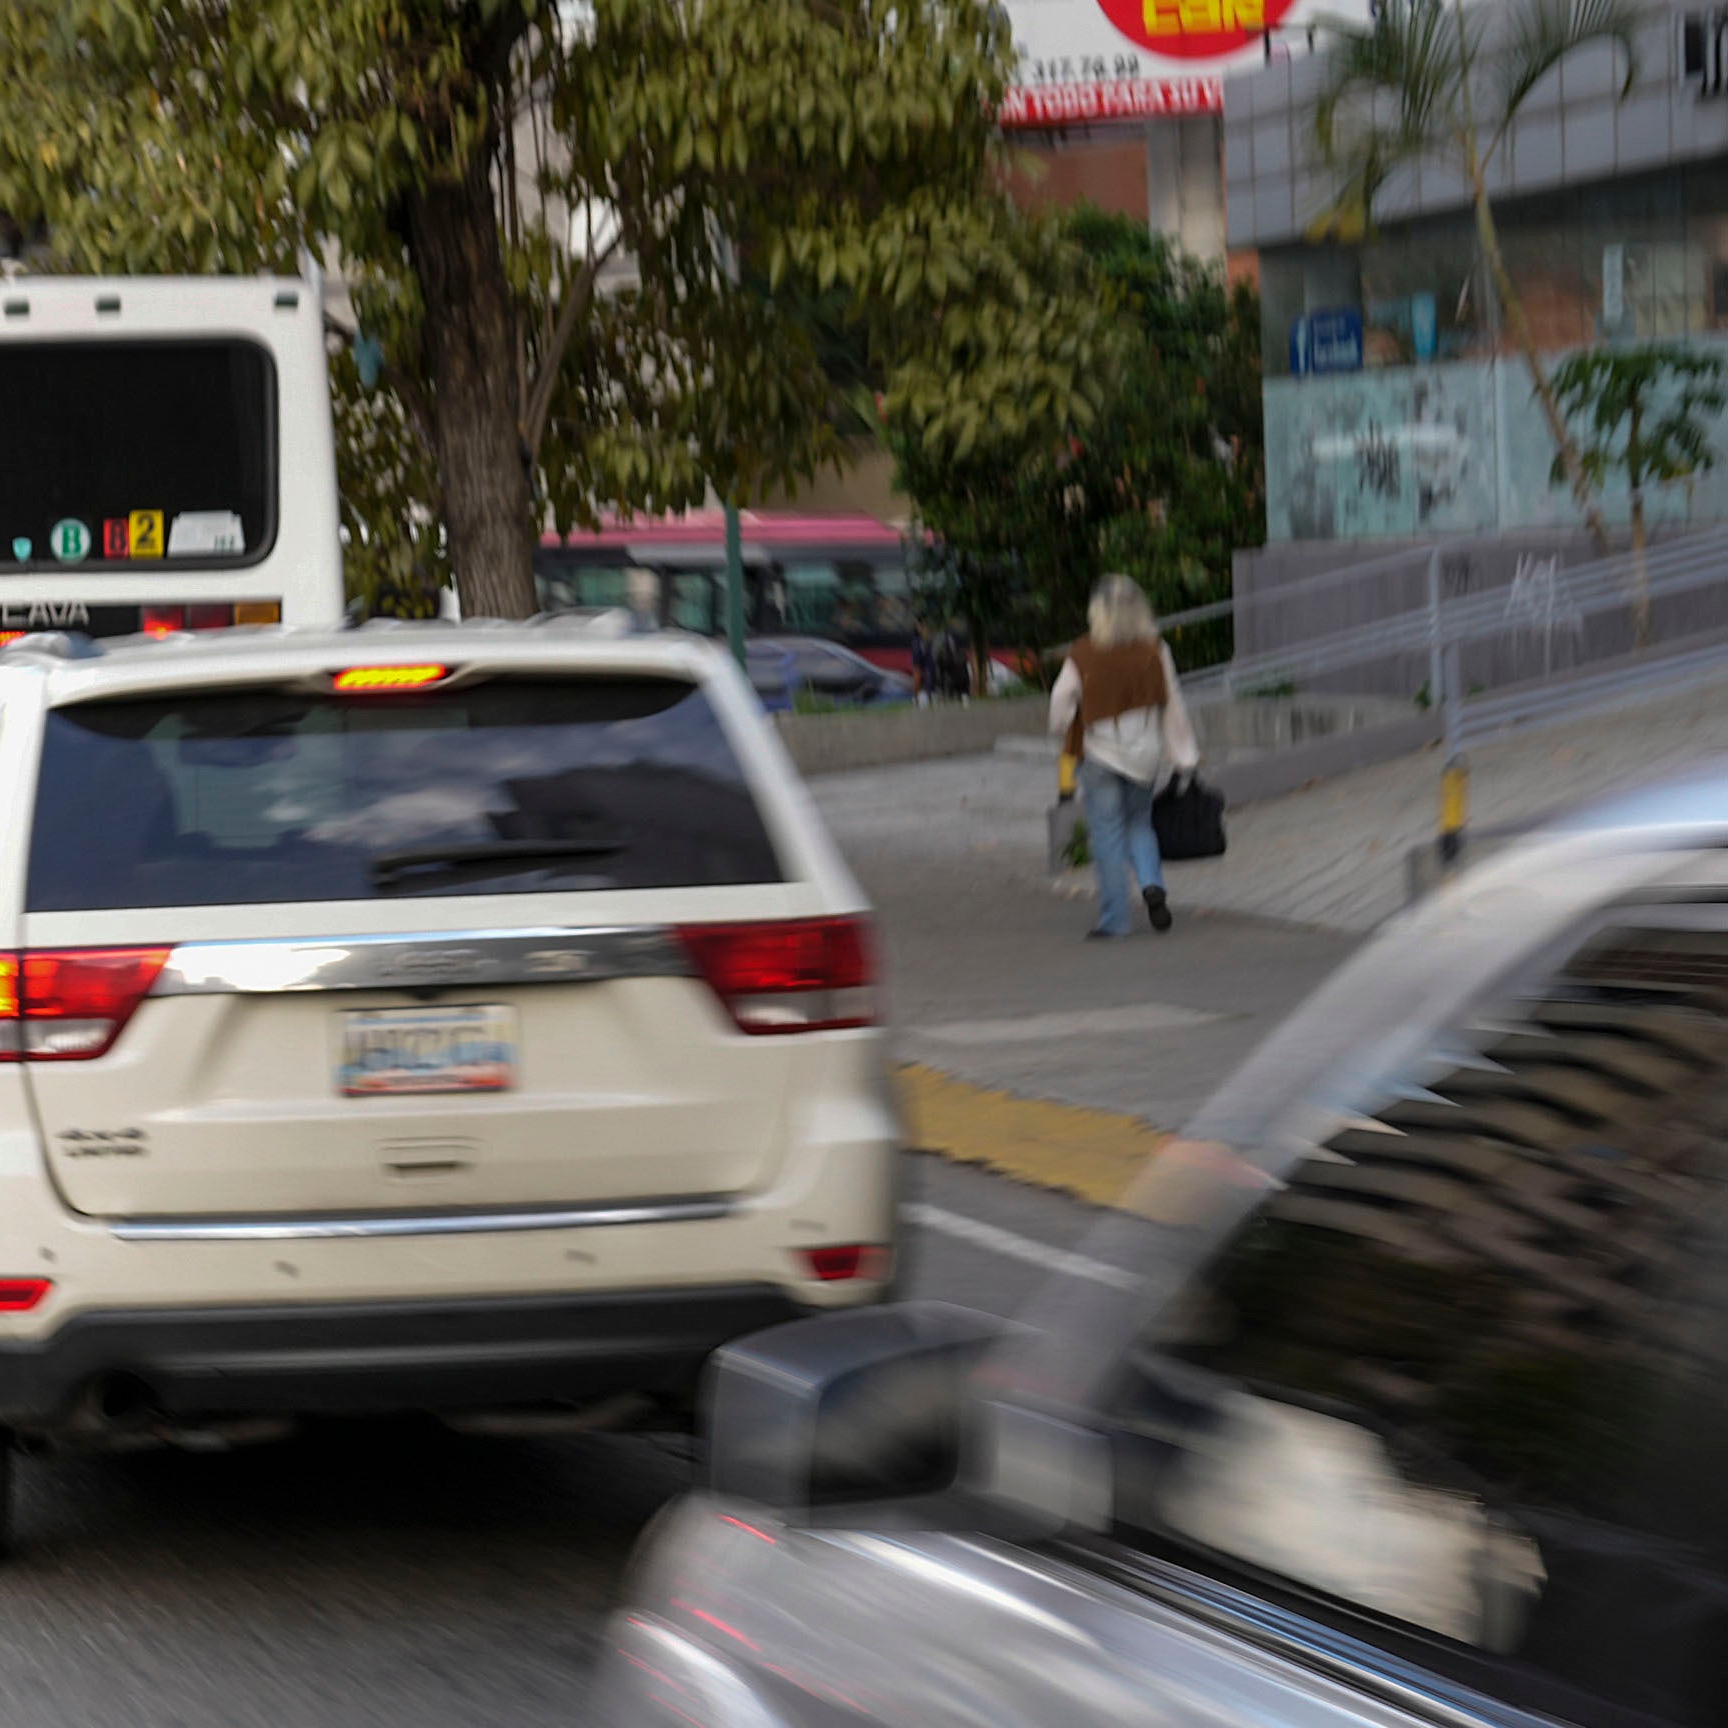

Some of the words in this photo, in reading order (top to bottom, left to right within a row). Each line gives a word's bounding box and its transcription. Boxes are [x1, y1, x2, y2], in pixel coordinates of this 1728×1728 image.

[1102, 78, 1167, 116] PARA
[62, 523, 83, 554] B
[136, 512, 156, 545] 2
